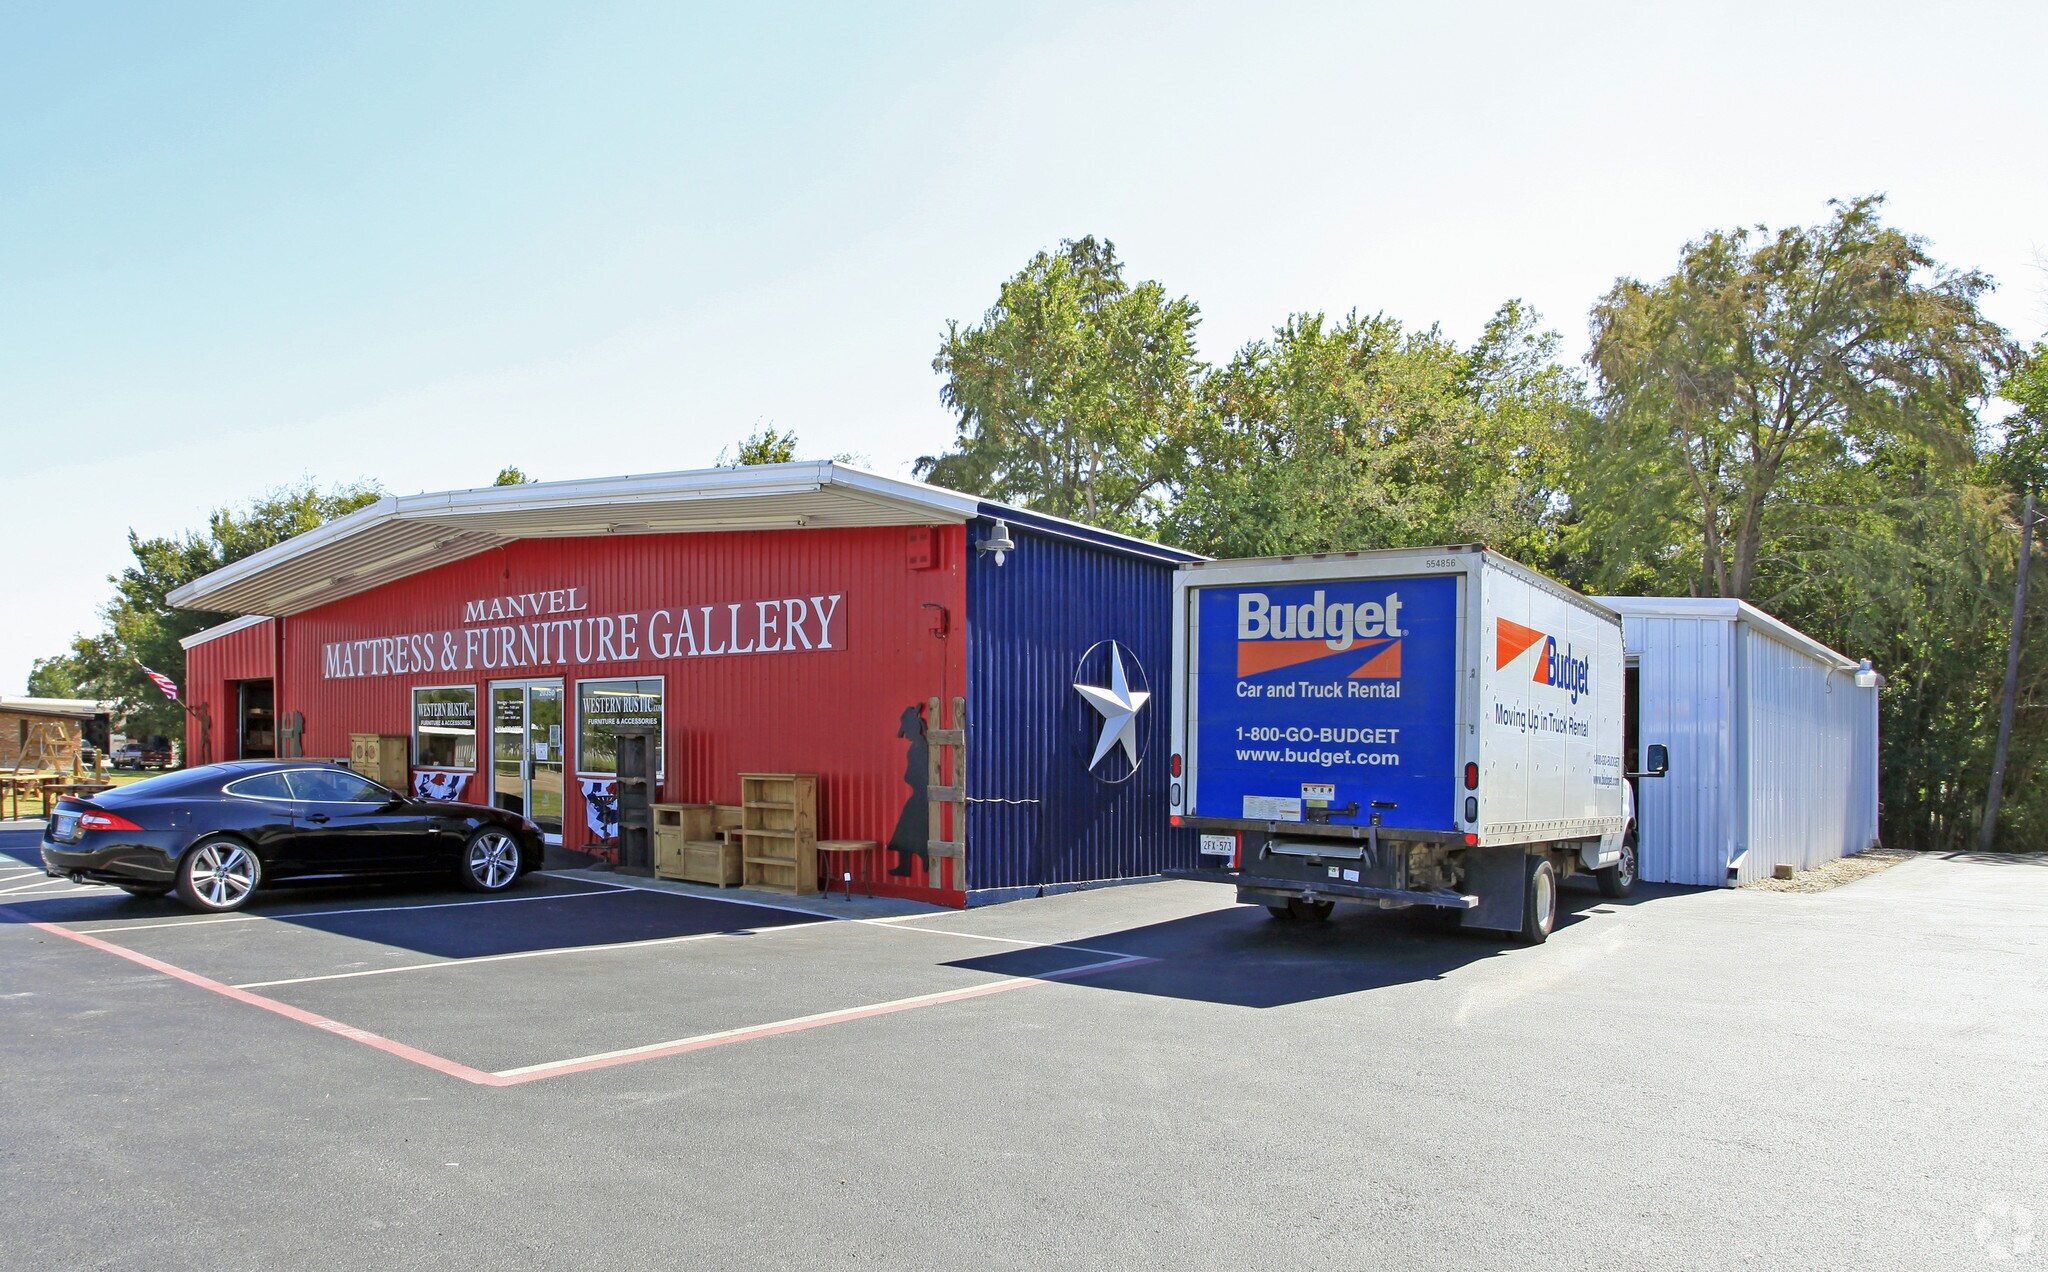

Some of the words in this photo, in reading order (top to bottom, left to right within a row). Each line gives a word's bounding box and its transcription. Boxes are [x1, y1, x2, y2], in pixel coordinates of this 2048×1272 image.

[1426, 559, 1456, 568] 554856
[464, 587, 588, 623] MANVEL
[1237, 590, 1403, 651] Budget
[324, 633, 435, 679] MATTRESS
[440, 632, 458, 671] &
[464, 613, 640, 669] FURNITURE
[648, 594, 841, 659] GALLERY
[1547, 635, 1589, 705] Budget
[1236, 681, 1263, 698] Car
[1266, 681, 1296, 698] and
[1298, 681, 1343, 698] Truck
[1347, 681, 1400, 698] Rental
[418, 703, 446, 717] WESTERN
[583, 697, 622, 714] WESTERN
[621, 717, 658, 725] ACCESSORIES
[1495, 703, 1526, 733] Moving
[1528, 708, 1539, 735] Up
[1540, 711, 1548, 731] in
[1549, 712, 1567, 734] Truck
[1568, 716, 1589, 737] Rental
[1236, 726, 1400, 744] 1-800-GO-BUDGET
[1236, 748, 1400, 767] www.budget.com
[1203, 840, 1232, 851] 2FX-573
